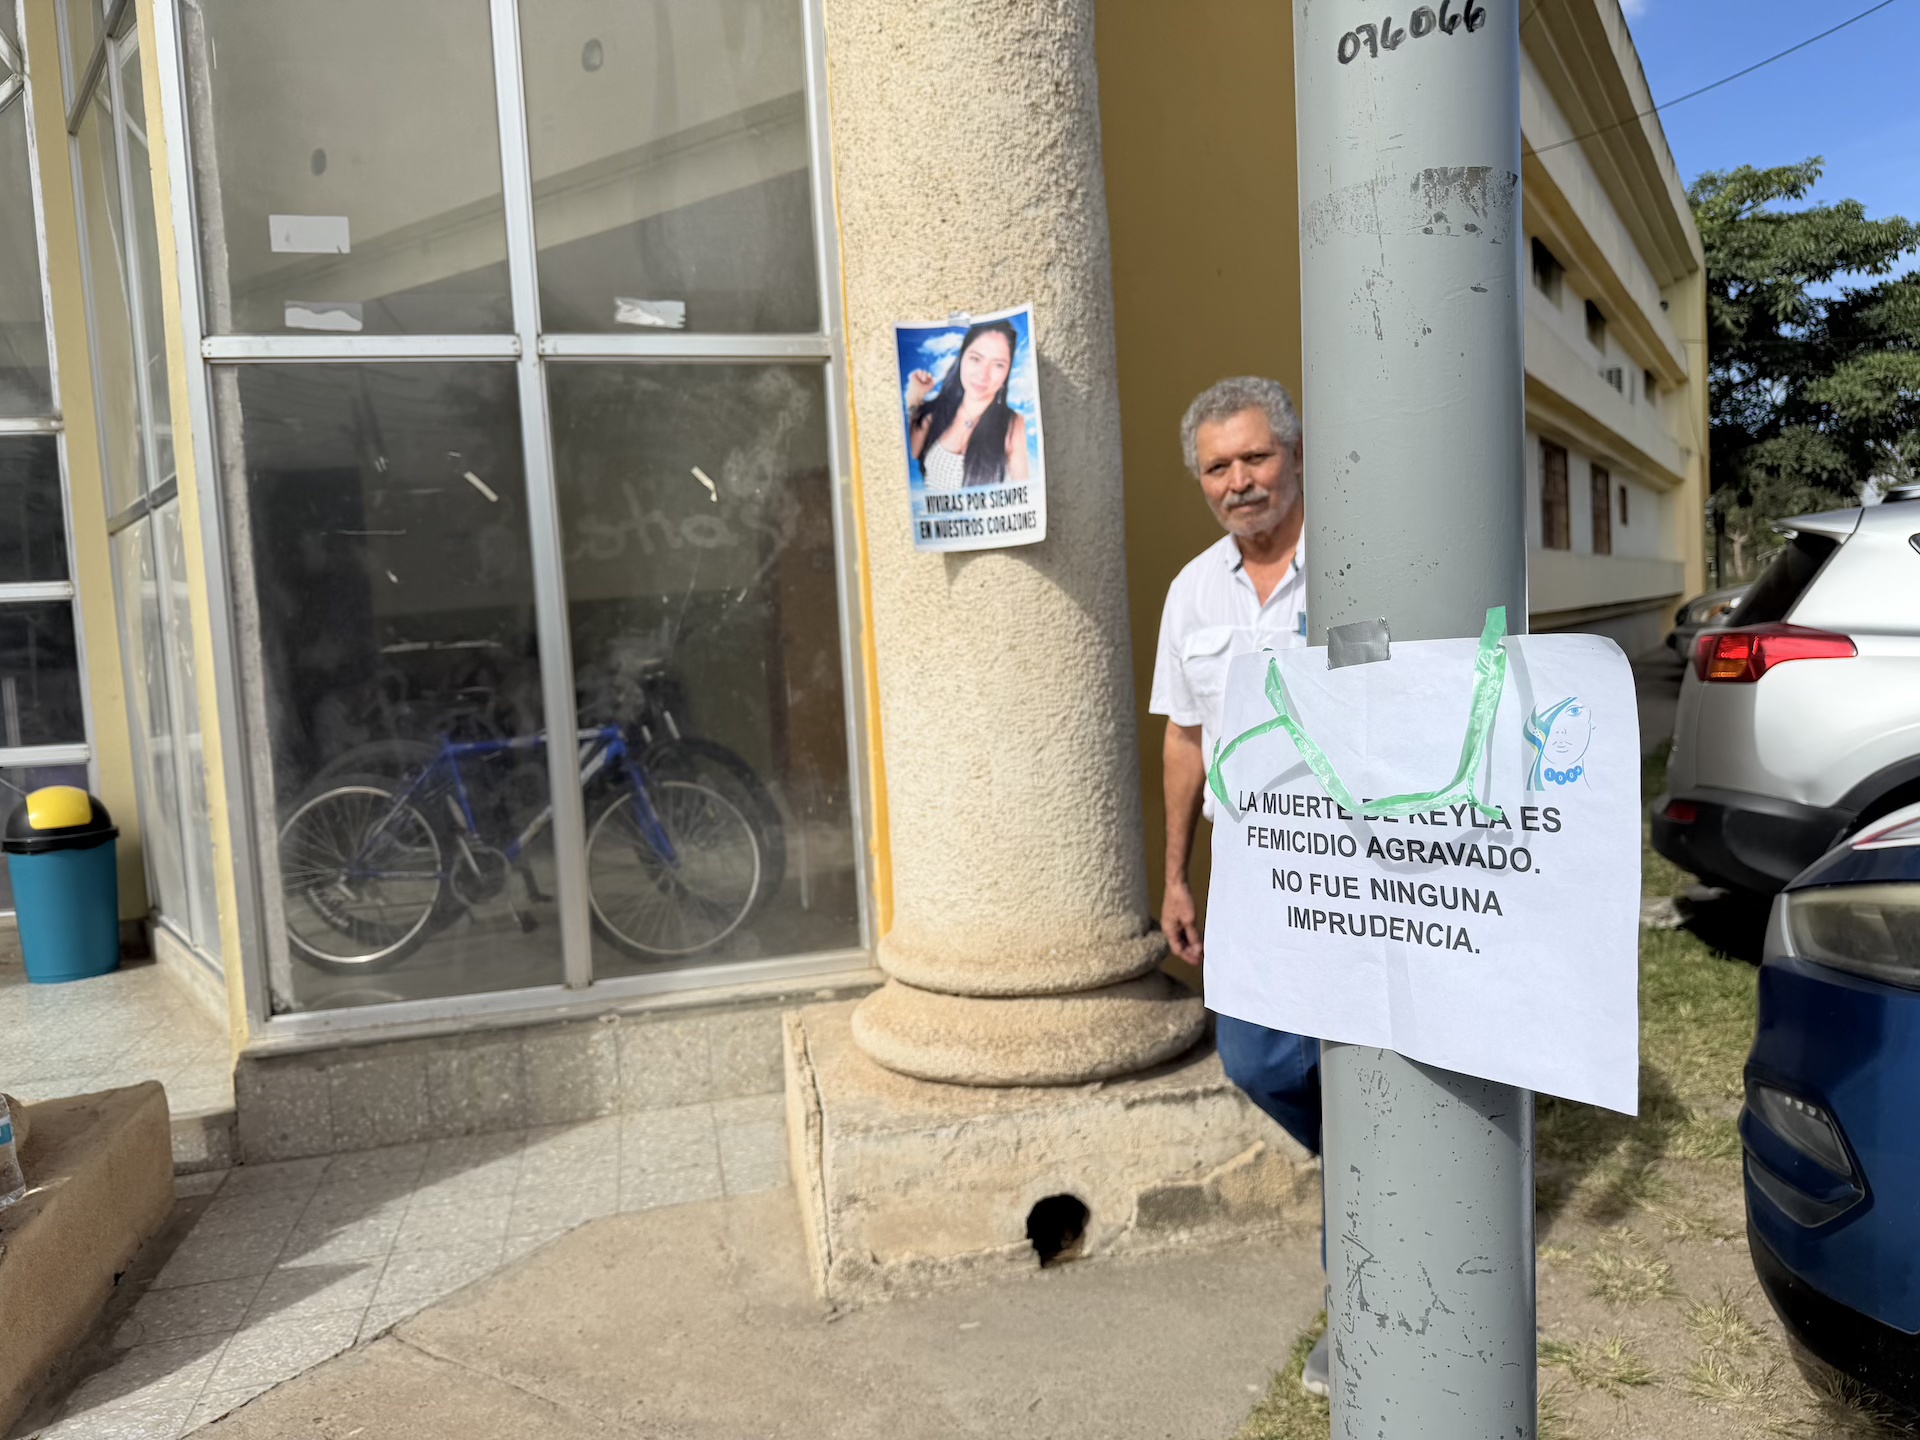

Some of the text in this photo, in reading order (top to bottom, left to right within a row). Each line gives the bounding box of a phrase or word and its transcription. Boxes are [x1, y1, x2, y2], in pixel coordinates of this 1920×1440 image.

[1337, 0, 1486, 64] 076066
[966, 492, 986, 511] POR
[989, 486, 1029, 509] SIEMPRE
[920, 511, 1037, 539] EN NUESTROS CORAZONES
[1239, 790, 1258, 813] LA
[1520, 806, 1562, 833] ES
[1247, 825, 1540, 874] FEMICIDIO AGRAVADO.
[1272, 868, 1503, 916] NO FUE NINGUNA
[1287, 905, 1480, 954] IMPRUDENCIA.
